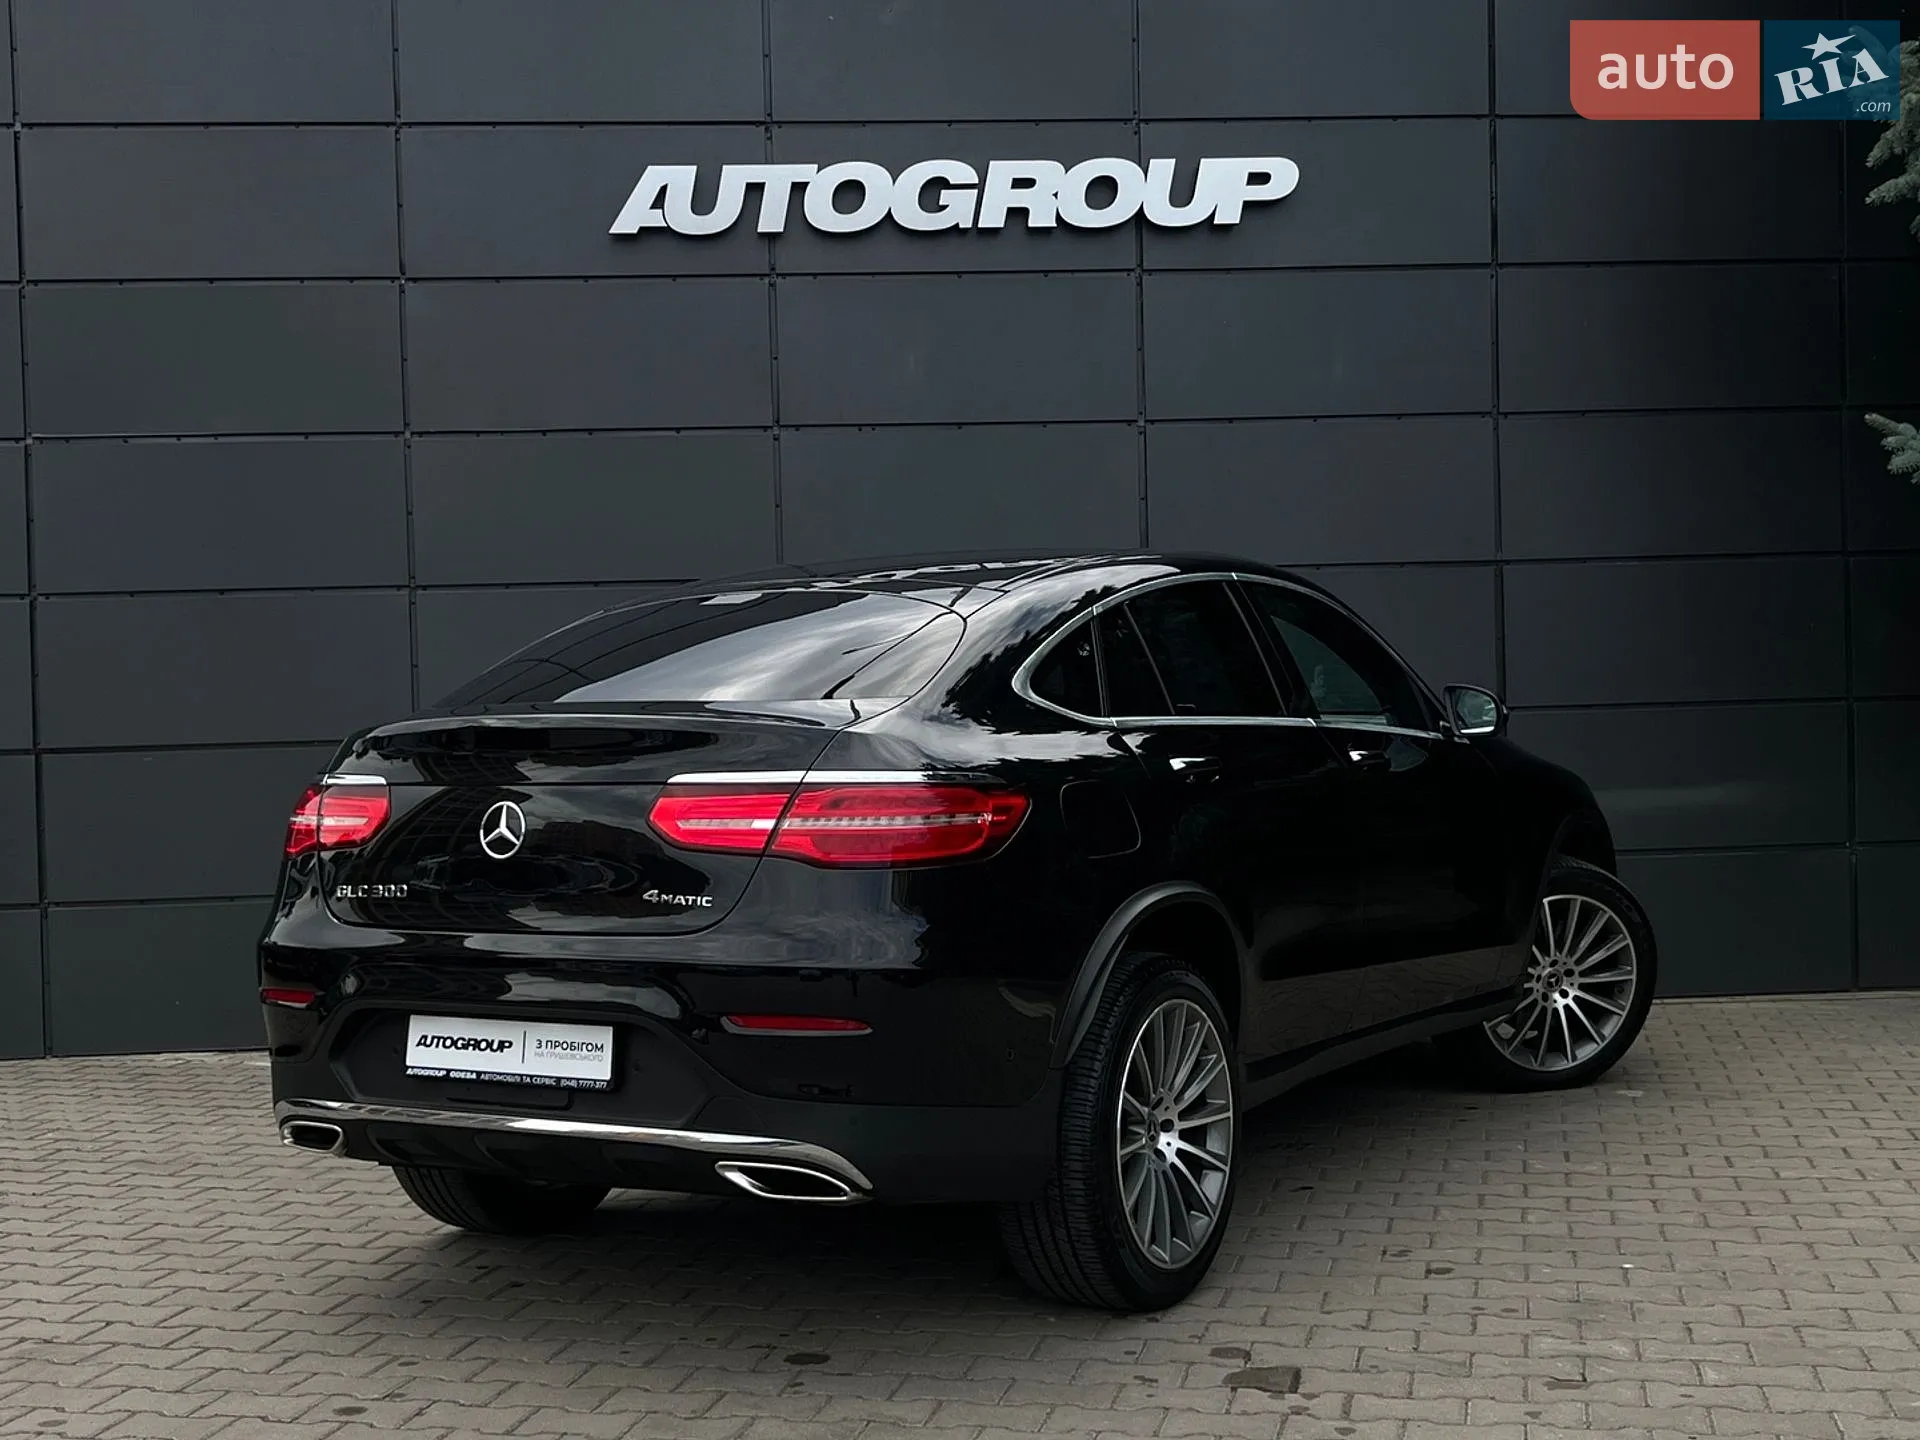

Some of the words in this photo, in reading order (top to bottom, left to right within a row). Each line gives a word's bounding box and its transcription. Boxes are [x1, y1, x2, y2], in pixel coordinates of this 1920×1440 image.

[608, 156, 1300, 235] AUTOGROUP
[336, 884, 368, 899] GLC
[371, 884, 408, 899] 300
[642, 889, 713, 908] 4MATIC
[416, 1034, 513, 1053] AUTOGROUP
[545, 1039, 604, 1054] ПРОБІГОМ
